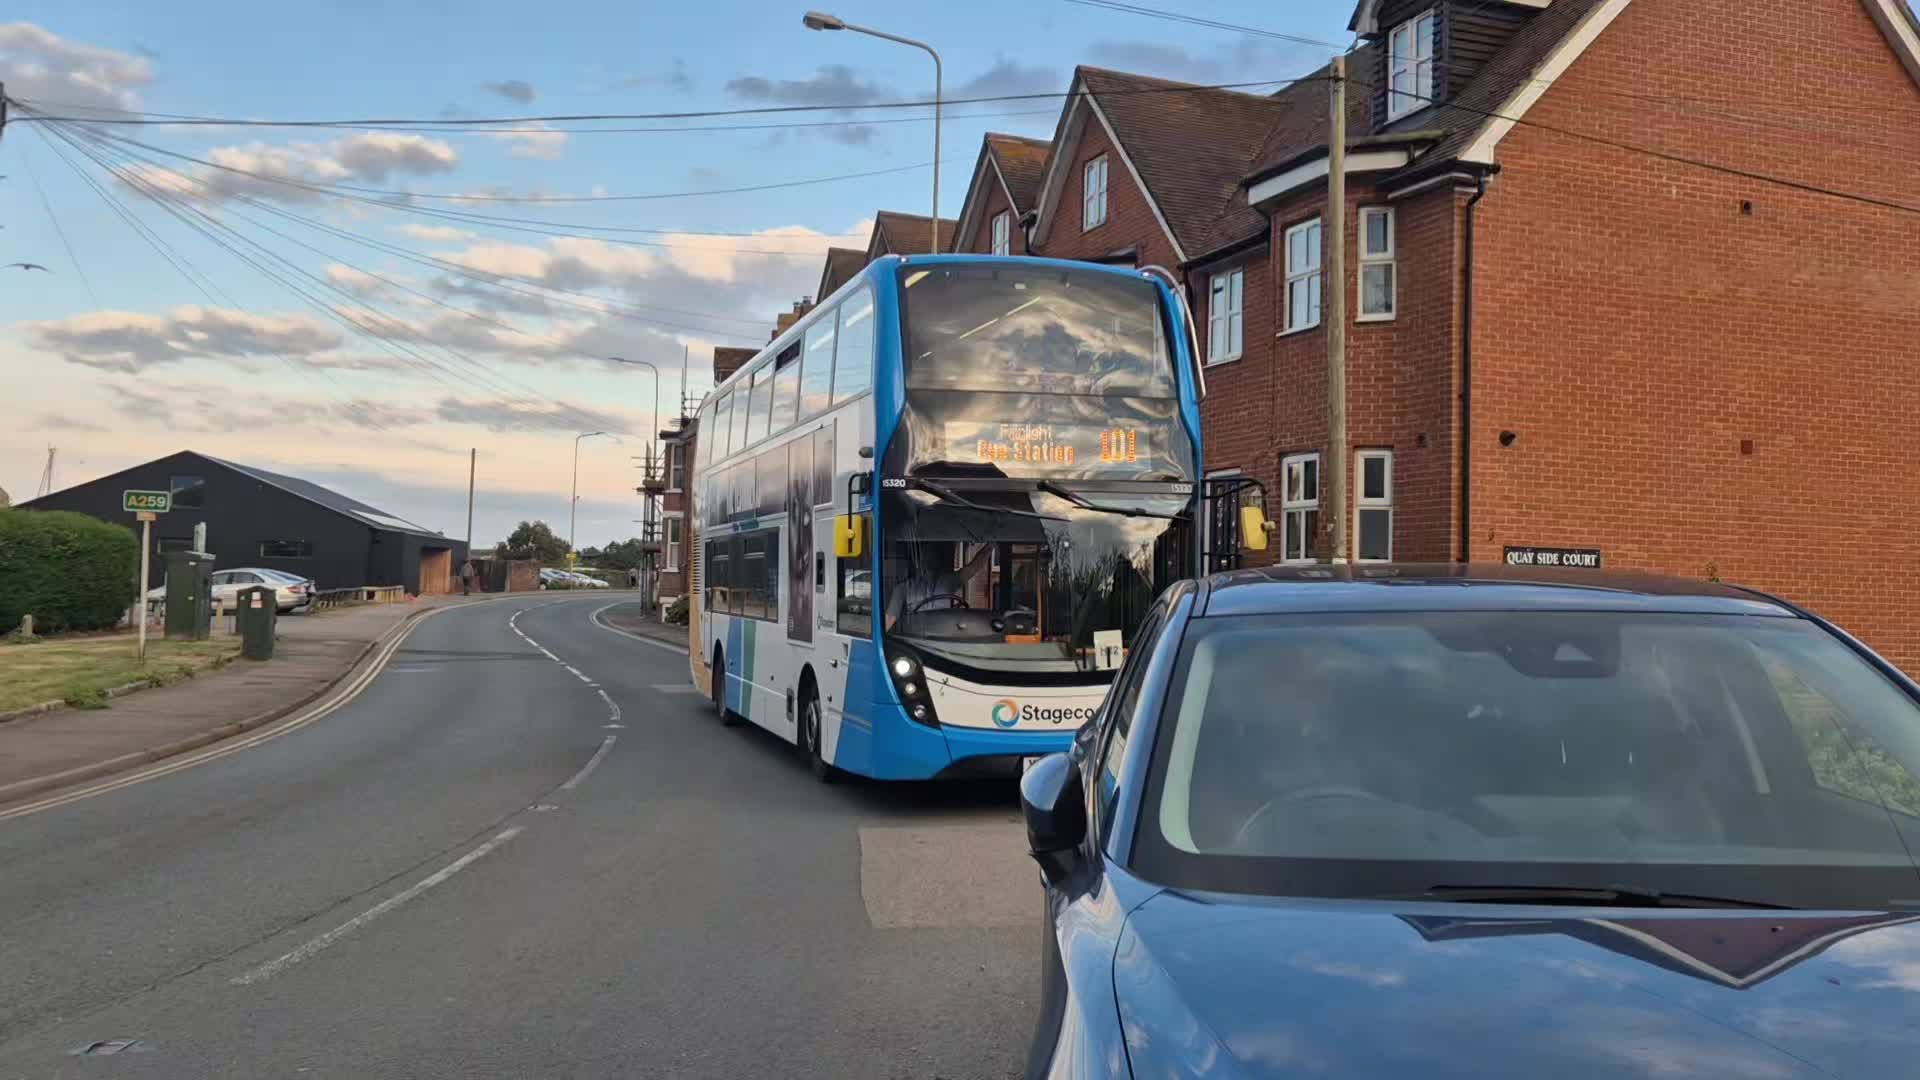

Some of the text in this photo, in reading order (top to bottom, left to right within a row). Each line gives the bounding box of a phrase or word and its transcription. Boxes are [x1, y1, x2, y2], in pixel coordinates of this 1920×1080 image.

[1014, 441, 1076, 464] Station
[1101, 428, 1136, 463] 101
[882, 479, 906, 488] 15320
[128, 495, 166, 508] A259
[1507, 552, 1597, 566] QUAY SIDE COURT
[1022, 704, 1095, 724] Stageco
